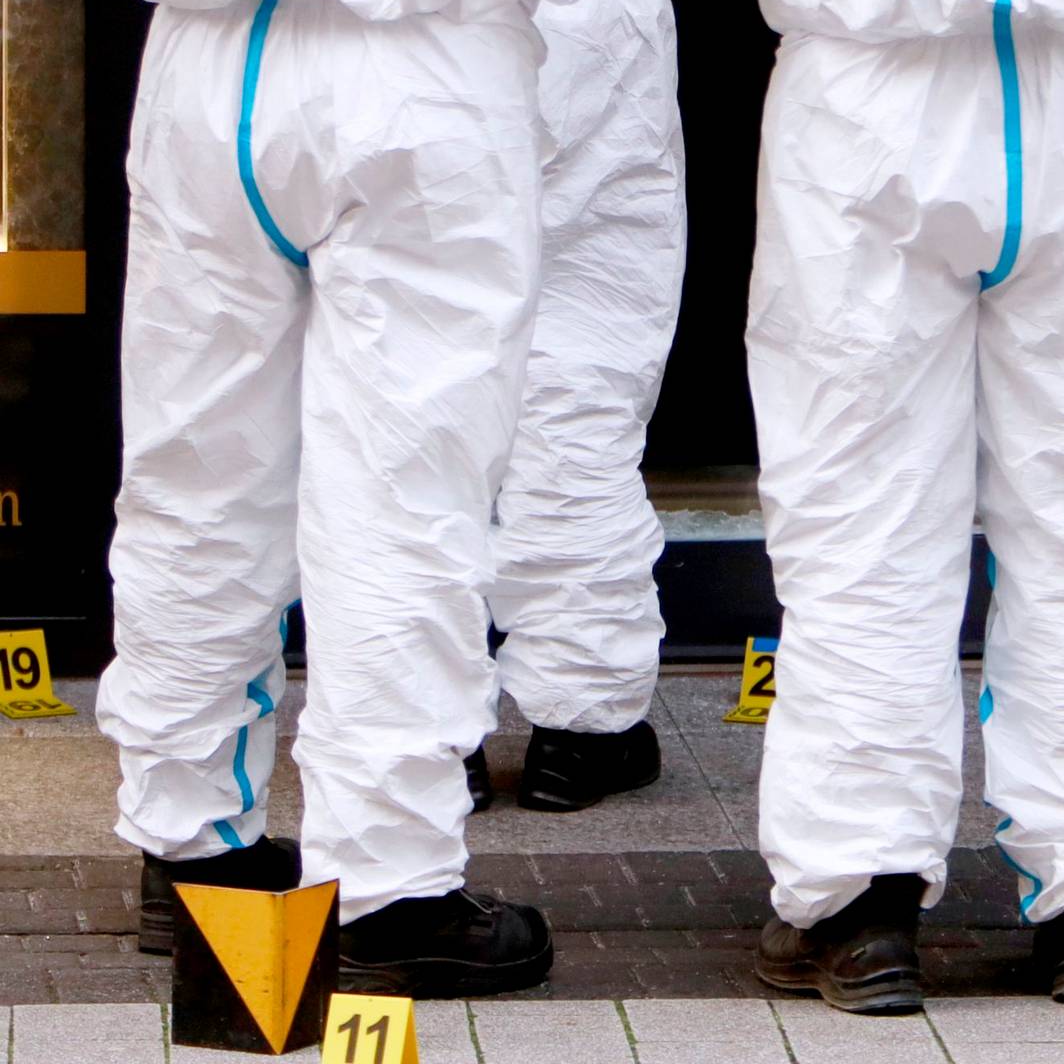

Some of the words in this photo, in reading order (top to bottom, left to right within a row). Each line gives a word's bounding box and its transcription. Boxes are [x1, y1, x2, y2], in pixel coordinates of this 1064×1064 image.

[0, 647, 40, 691] 19
[748, 655, 777, 697] 2
[337, 1013, 390, 1064] 11
